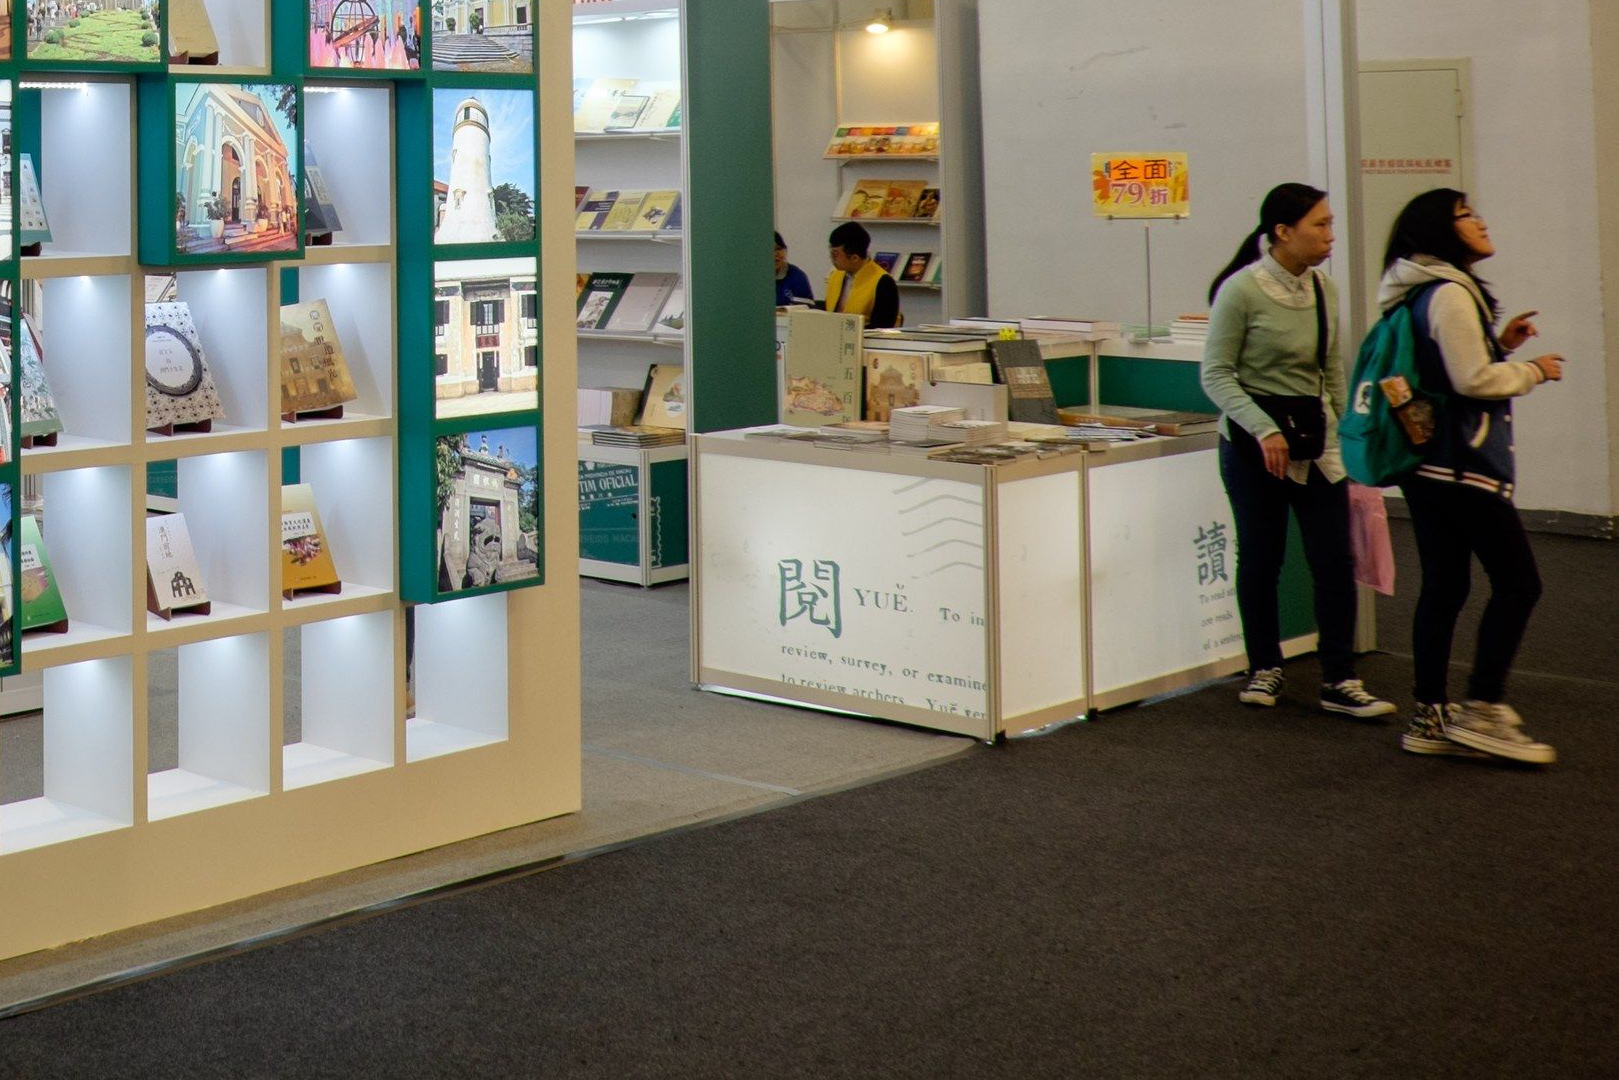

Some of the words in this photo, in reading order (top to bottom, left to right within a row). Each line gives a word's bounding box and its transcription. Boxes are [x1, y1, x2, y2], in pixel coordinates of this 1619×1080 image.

[1113, 159, 1167, 180] 全面
[1110, 182, 1144, 205] 79
[1149, 188, 1168, 205] 折
[599, 474, 638, 491] OFICIAL
[1193, 521, 1229, 586] 讀
[778, 558, 843, 639] 閱
[939, 608, 960, 622] To
[781, 645, 833, 664] review,
[841, 655, 893, 677] survey,
[902, 668, 919, 680] or
